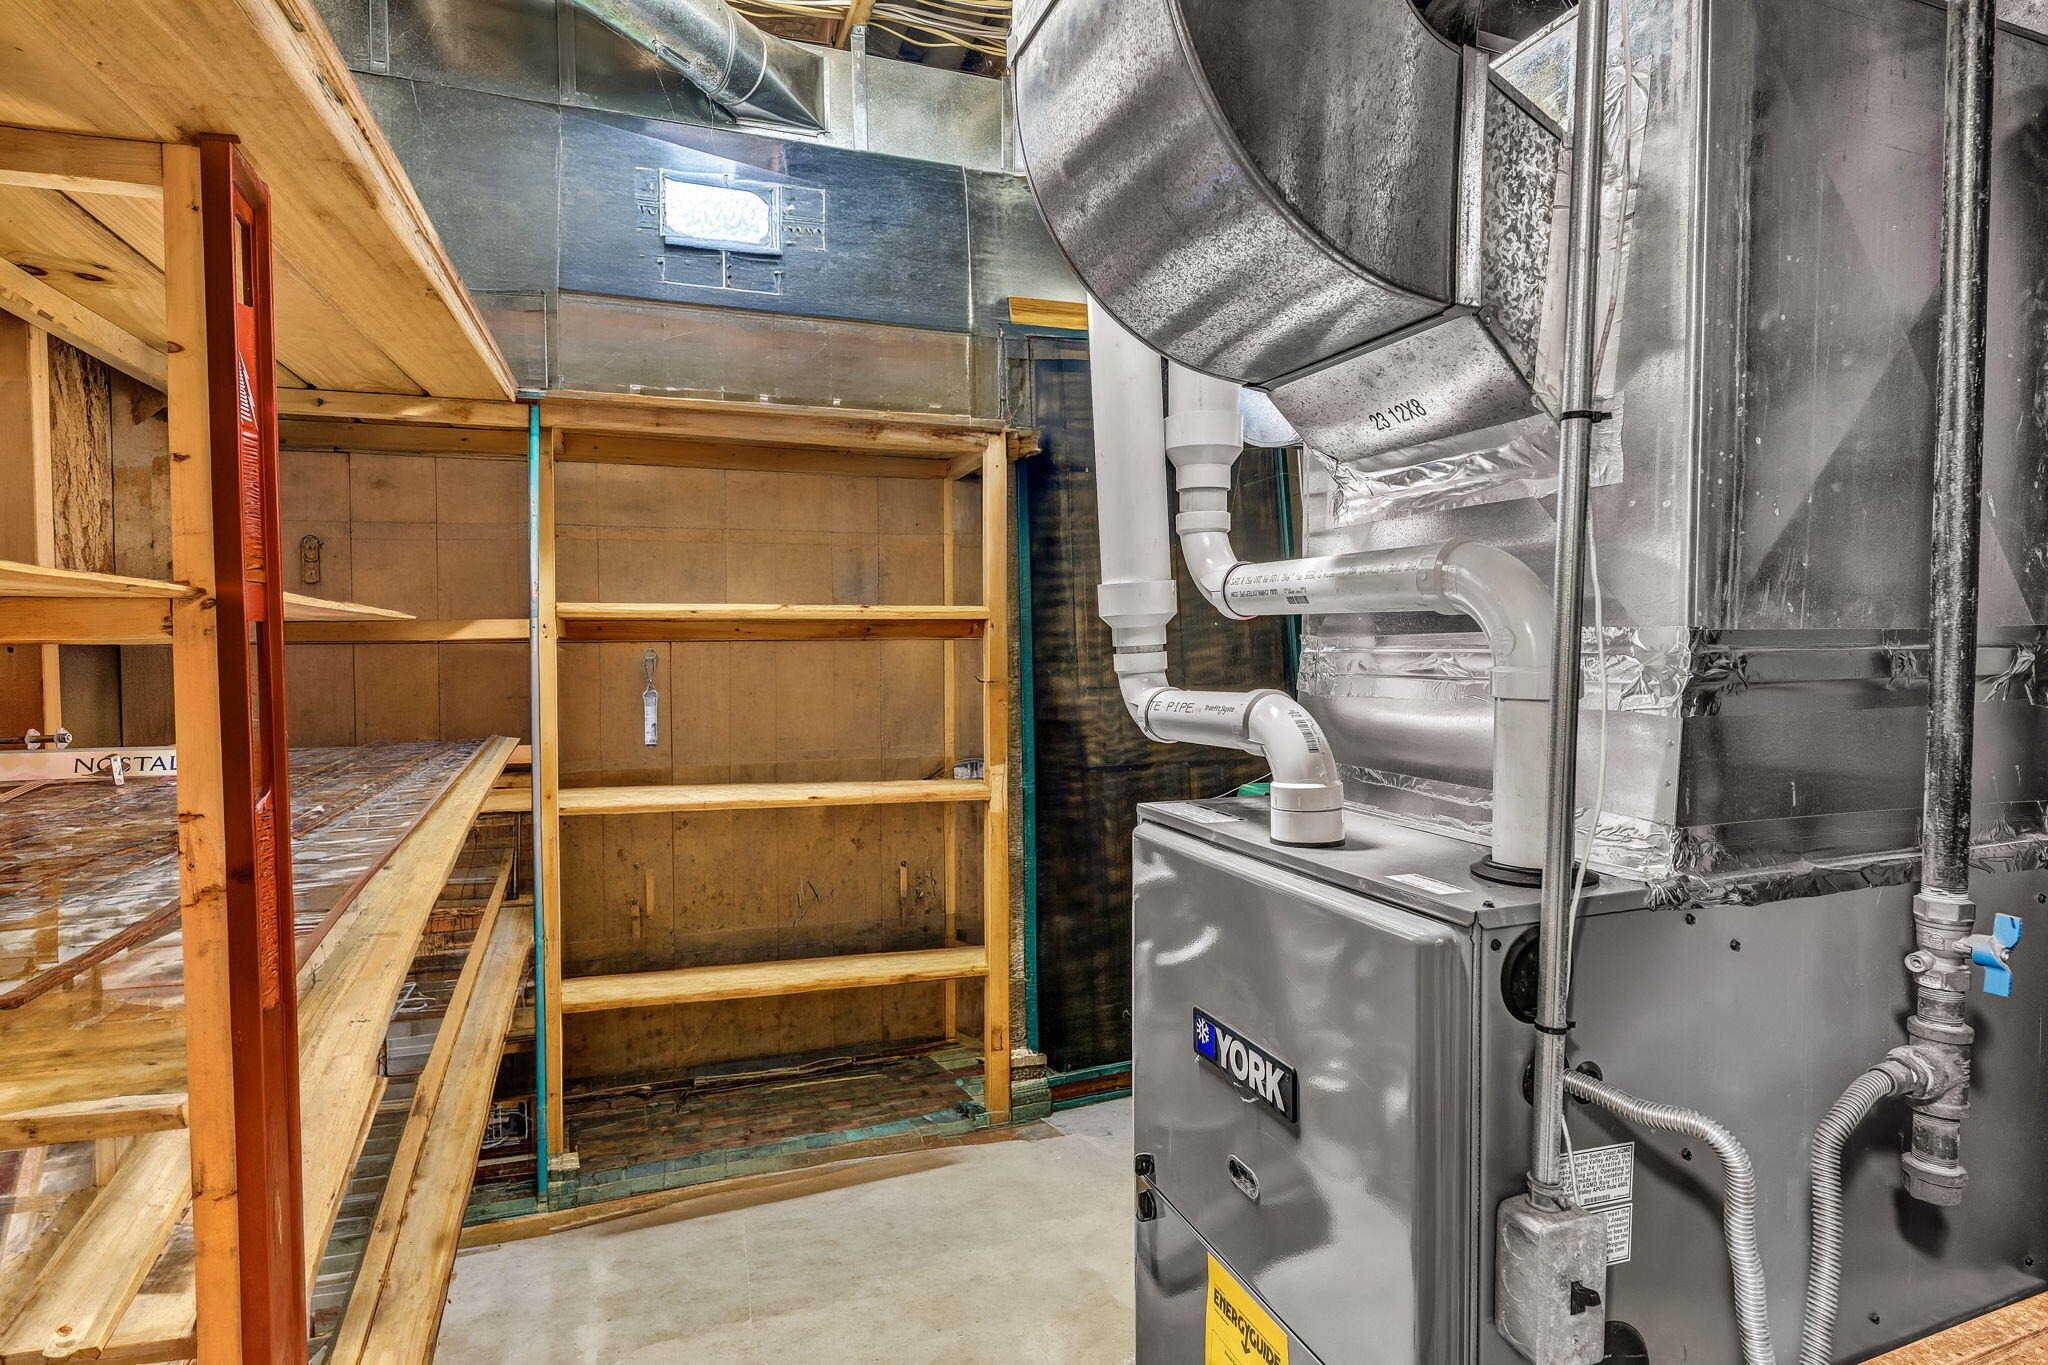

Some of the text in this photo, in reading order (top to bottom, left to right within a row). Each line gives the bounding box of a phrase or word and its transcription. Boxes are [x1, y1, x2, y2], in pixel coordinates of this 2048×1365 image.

[1369, 398, 1426, 430] 23 12X8
[1166, 701, 1195, 714] PIPE
[1215, 1026, 1285, 1112] YORK
[1597, 1160, 1621, 1168] installed
